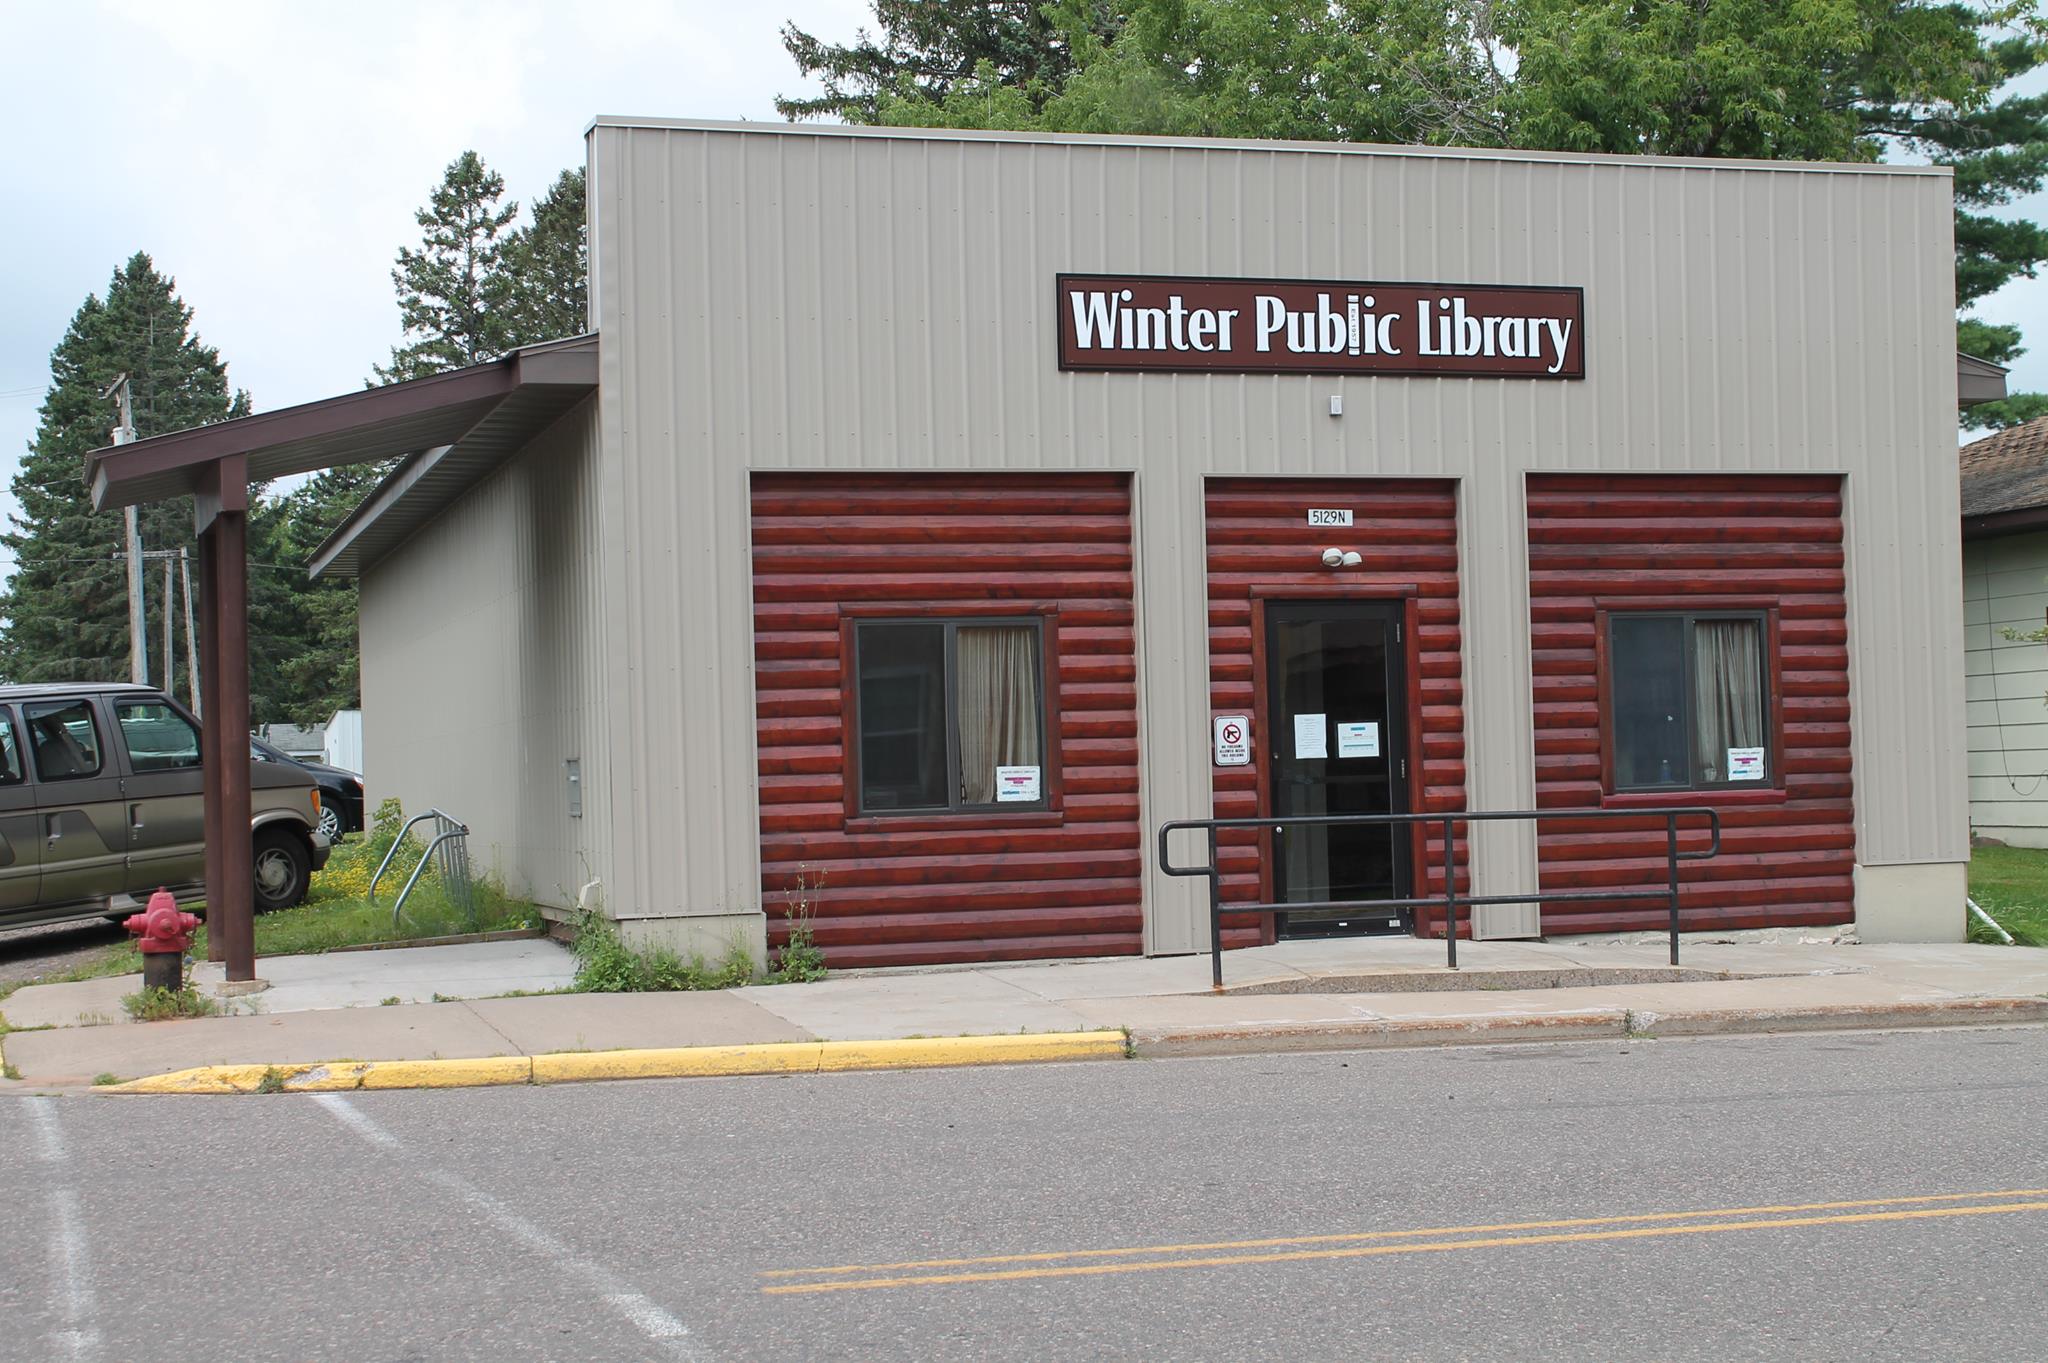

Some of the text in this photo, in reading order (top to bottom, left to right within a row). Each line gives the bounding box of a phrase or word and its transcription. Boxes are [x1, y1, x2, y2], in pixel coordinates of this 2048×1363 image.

[1069, 289, 1573, 374] Winter Public Library
[1312, 510, 1345, 523] 5129N
